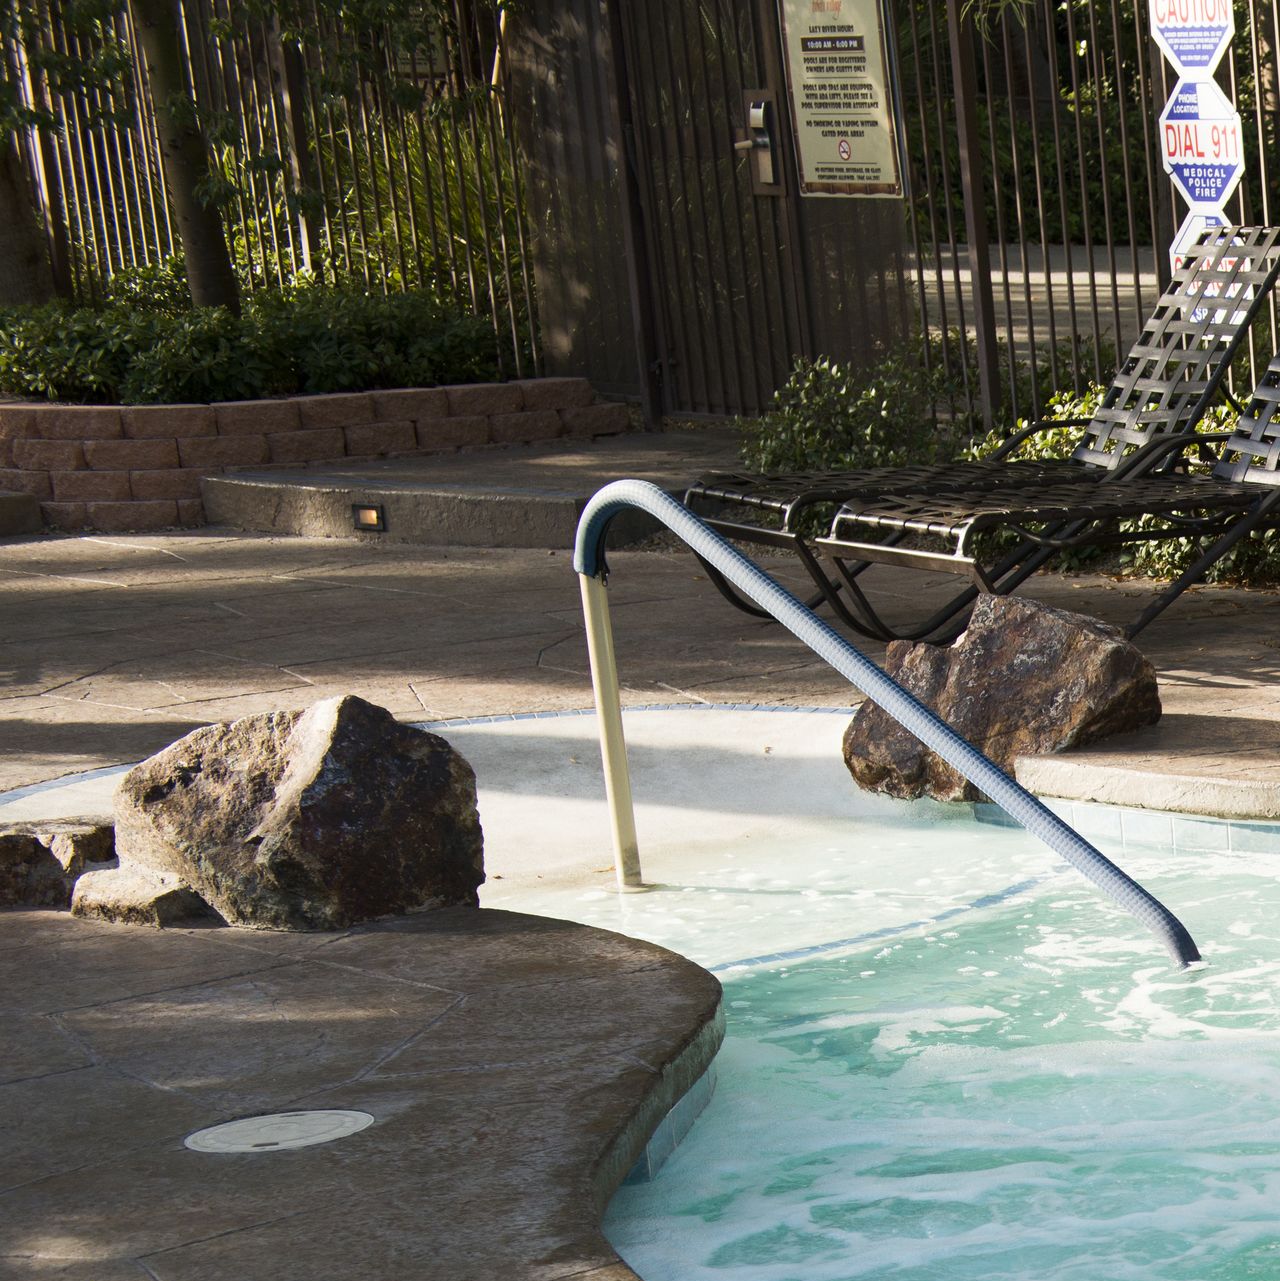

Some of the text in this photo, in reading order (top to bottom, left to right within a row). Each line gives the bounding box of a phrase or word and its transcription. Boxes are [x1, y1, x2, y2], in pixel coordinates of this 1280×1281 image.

[822, 25, 836, 33] RIVER
[1178, 94, 1198, 103] PHONE
[1173, 105, 1198, 113] LOCATION
[1165, 124, 1238, 158] DIAL 911
[1183, 168, 1226, 177] MEDICAL
[1189, 178, 1222, 187] POLICE
[1195, 188, 1216, 197] FIRE
